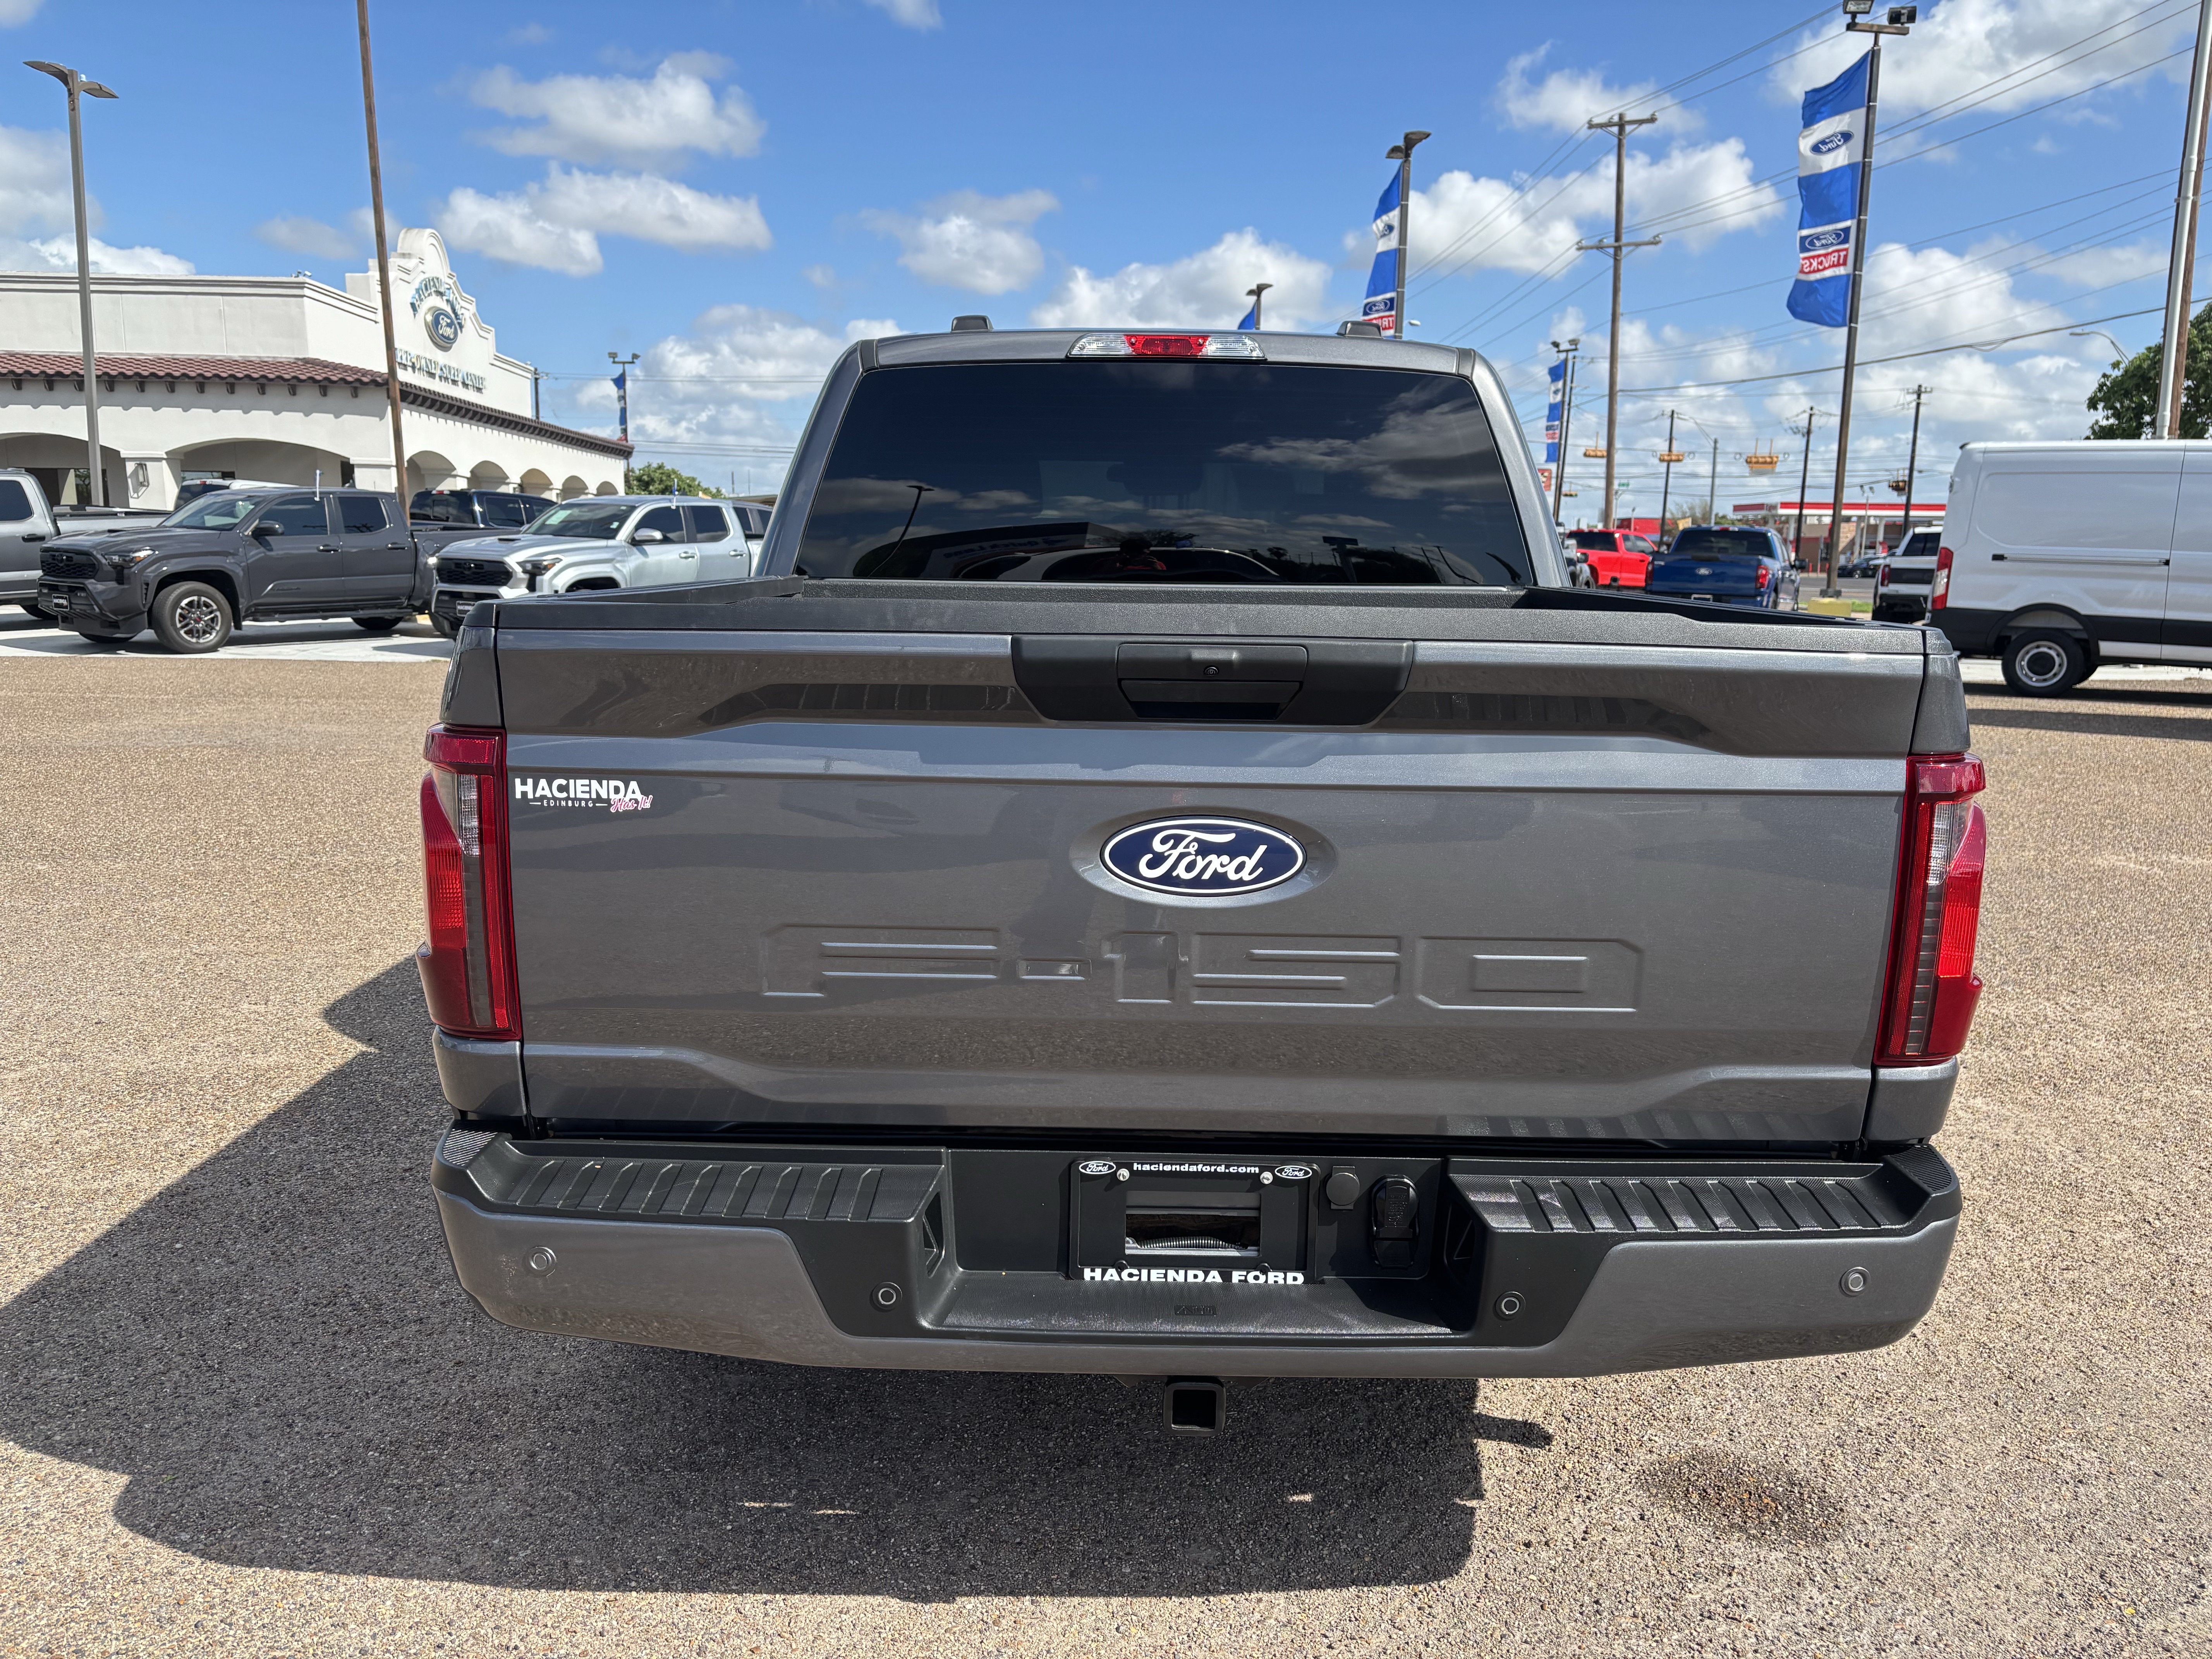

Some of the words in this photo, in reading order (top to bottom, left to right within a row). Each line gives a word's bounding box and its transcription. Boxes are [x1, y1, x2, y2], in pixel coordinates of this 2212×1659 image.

[438, 315, 455, 339] Ford
[515, 778, 642, 800] HACIENDA
[610, 797, 637, 812] Has
[1139, 829, 1267, 881] Ford
[762, 924, 1642, 1012] F-150
[1086, 1163, 1109, 1172] Ford
[1133, 1163, 1259, 1173] haciendaford.com
[1282, 1167, 1305, 1177] Ford
[1084, 1268, 1223, 1283] HACIENDA
[1231, 1271, 1304, 1285] FORD
